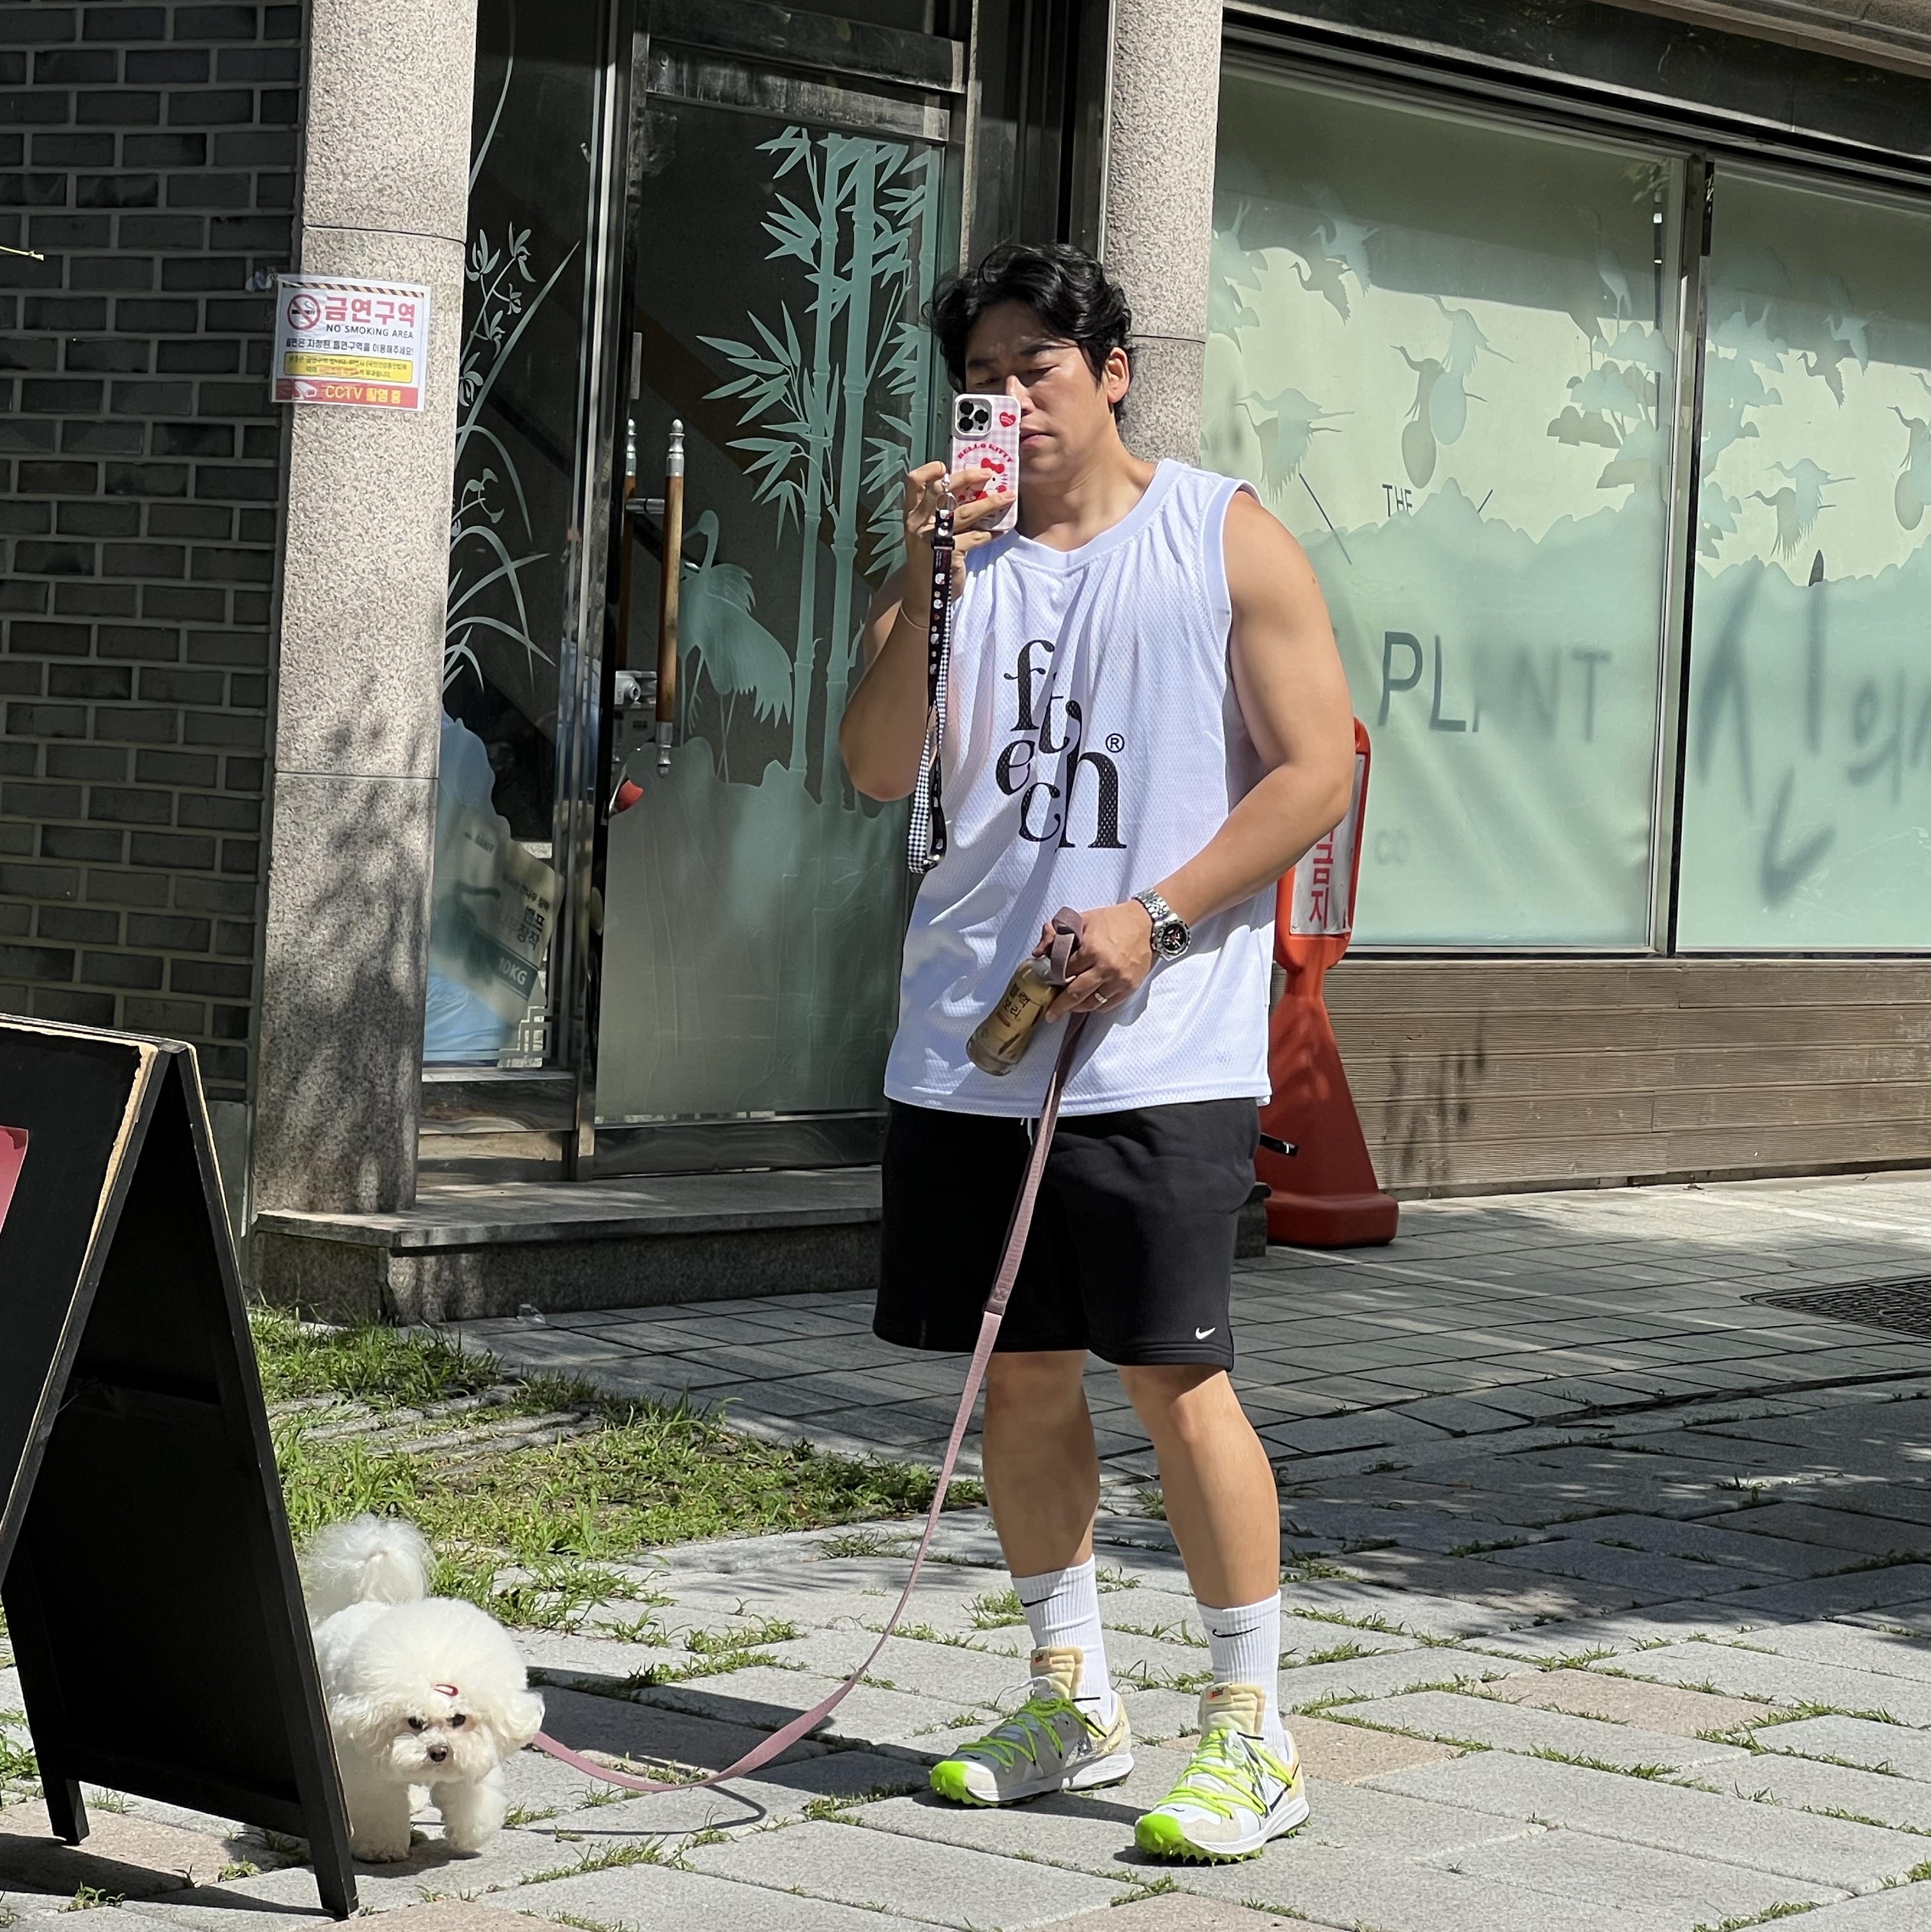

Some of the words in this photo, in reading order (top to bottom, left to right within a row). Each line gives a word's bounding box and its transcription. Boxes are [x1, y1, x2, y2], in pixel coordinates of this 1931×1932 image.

[325, 296, 415, 328] 금연구역
[345, 325, 388, 337] SMOKING
[392, 330, 413, 338] AREA
[307, 339, 330, 349] 지정된
[326, 385, 363, 400] CCTV
[391, 390, 401, 404] 중
[989, 444, 1013, 462] KITTY
[517, 923, 539, 950] 장작
[499, 957, 528, 985] 10KG
